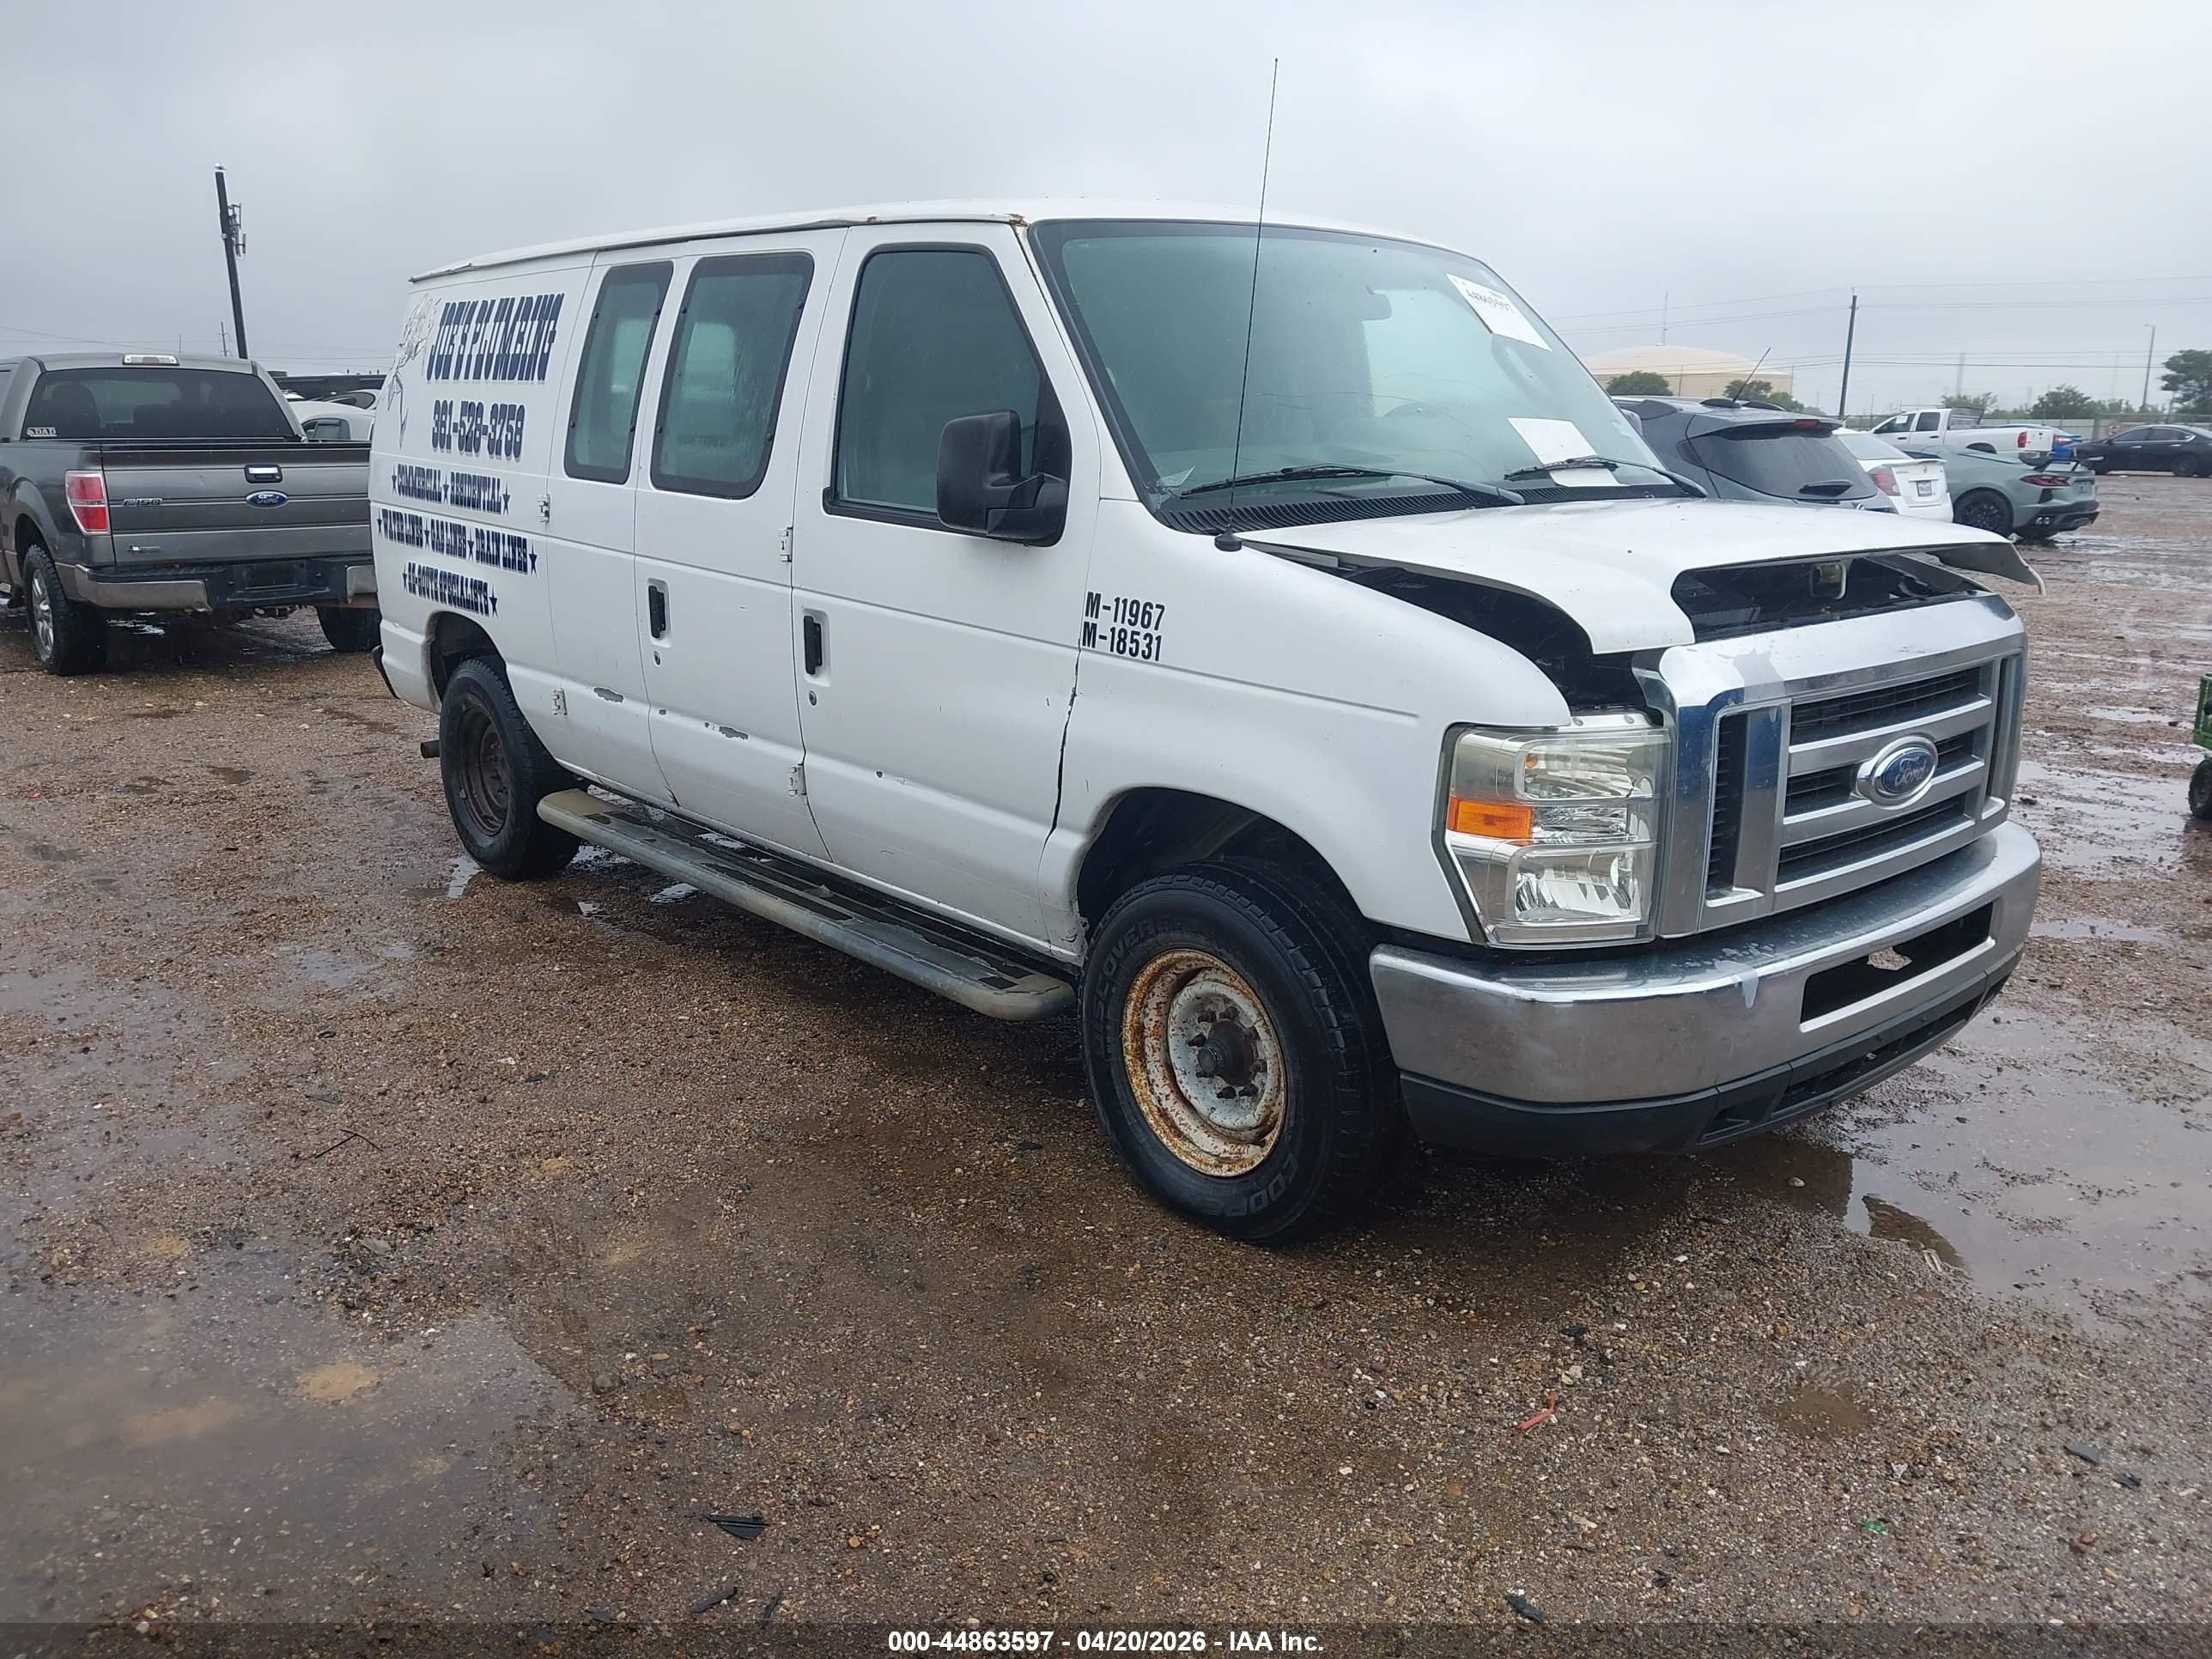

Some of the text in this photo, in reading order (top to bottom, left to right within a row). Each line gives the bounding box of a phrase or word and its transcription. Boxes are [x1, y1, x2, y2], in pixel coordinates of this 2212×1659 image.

[464, 292, 565, 380] PLUMBING
[397, 463, 502, 515] COMMERCIAL RESIDENTIAL
[381, 507, 424, 550] WATER LINES
[430, 518, 468, 561] GAS LINES
[475, 526, 529, 575] DRAIN LINES
[439, 569, 490, 617] SPECIALISTS
[1085, 591, 1166, 631] M-11967
[1082, 621, 1163, 662] M-18531
